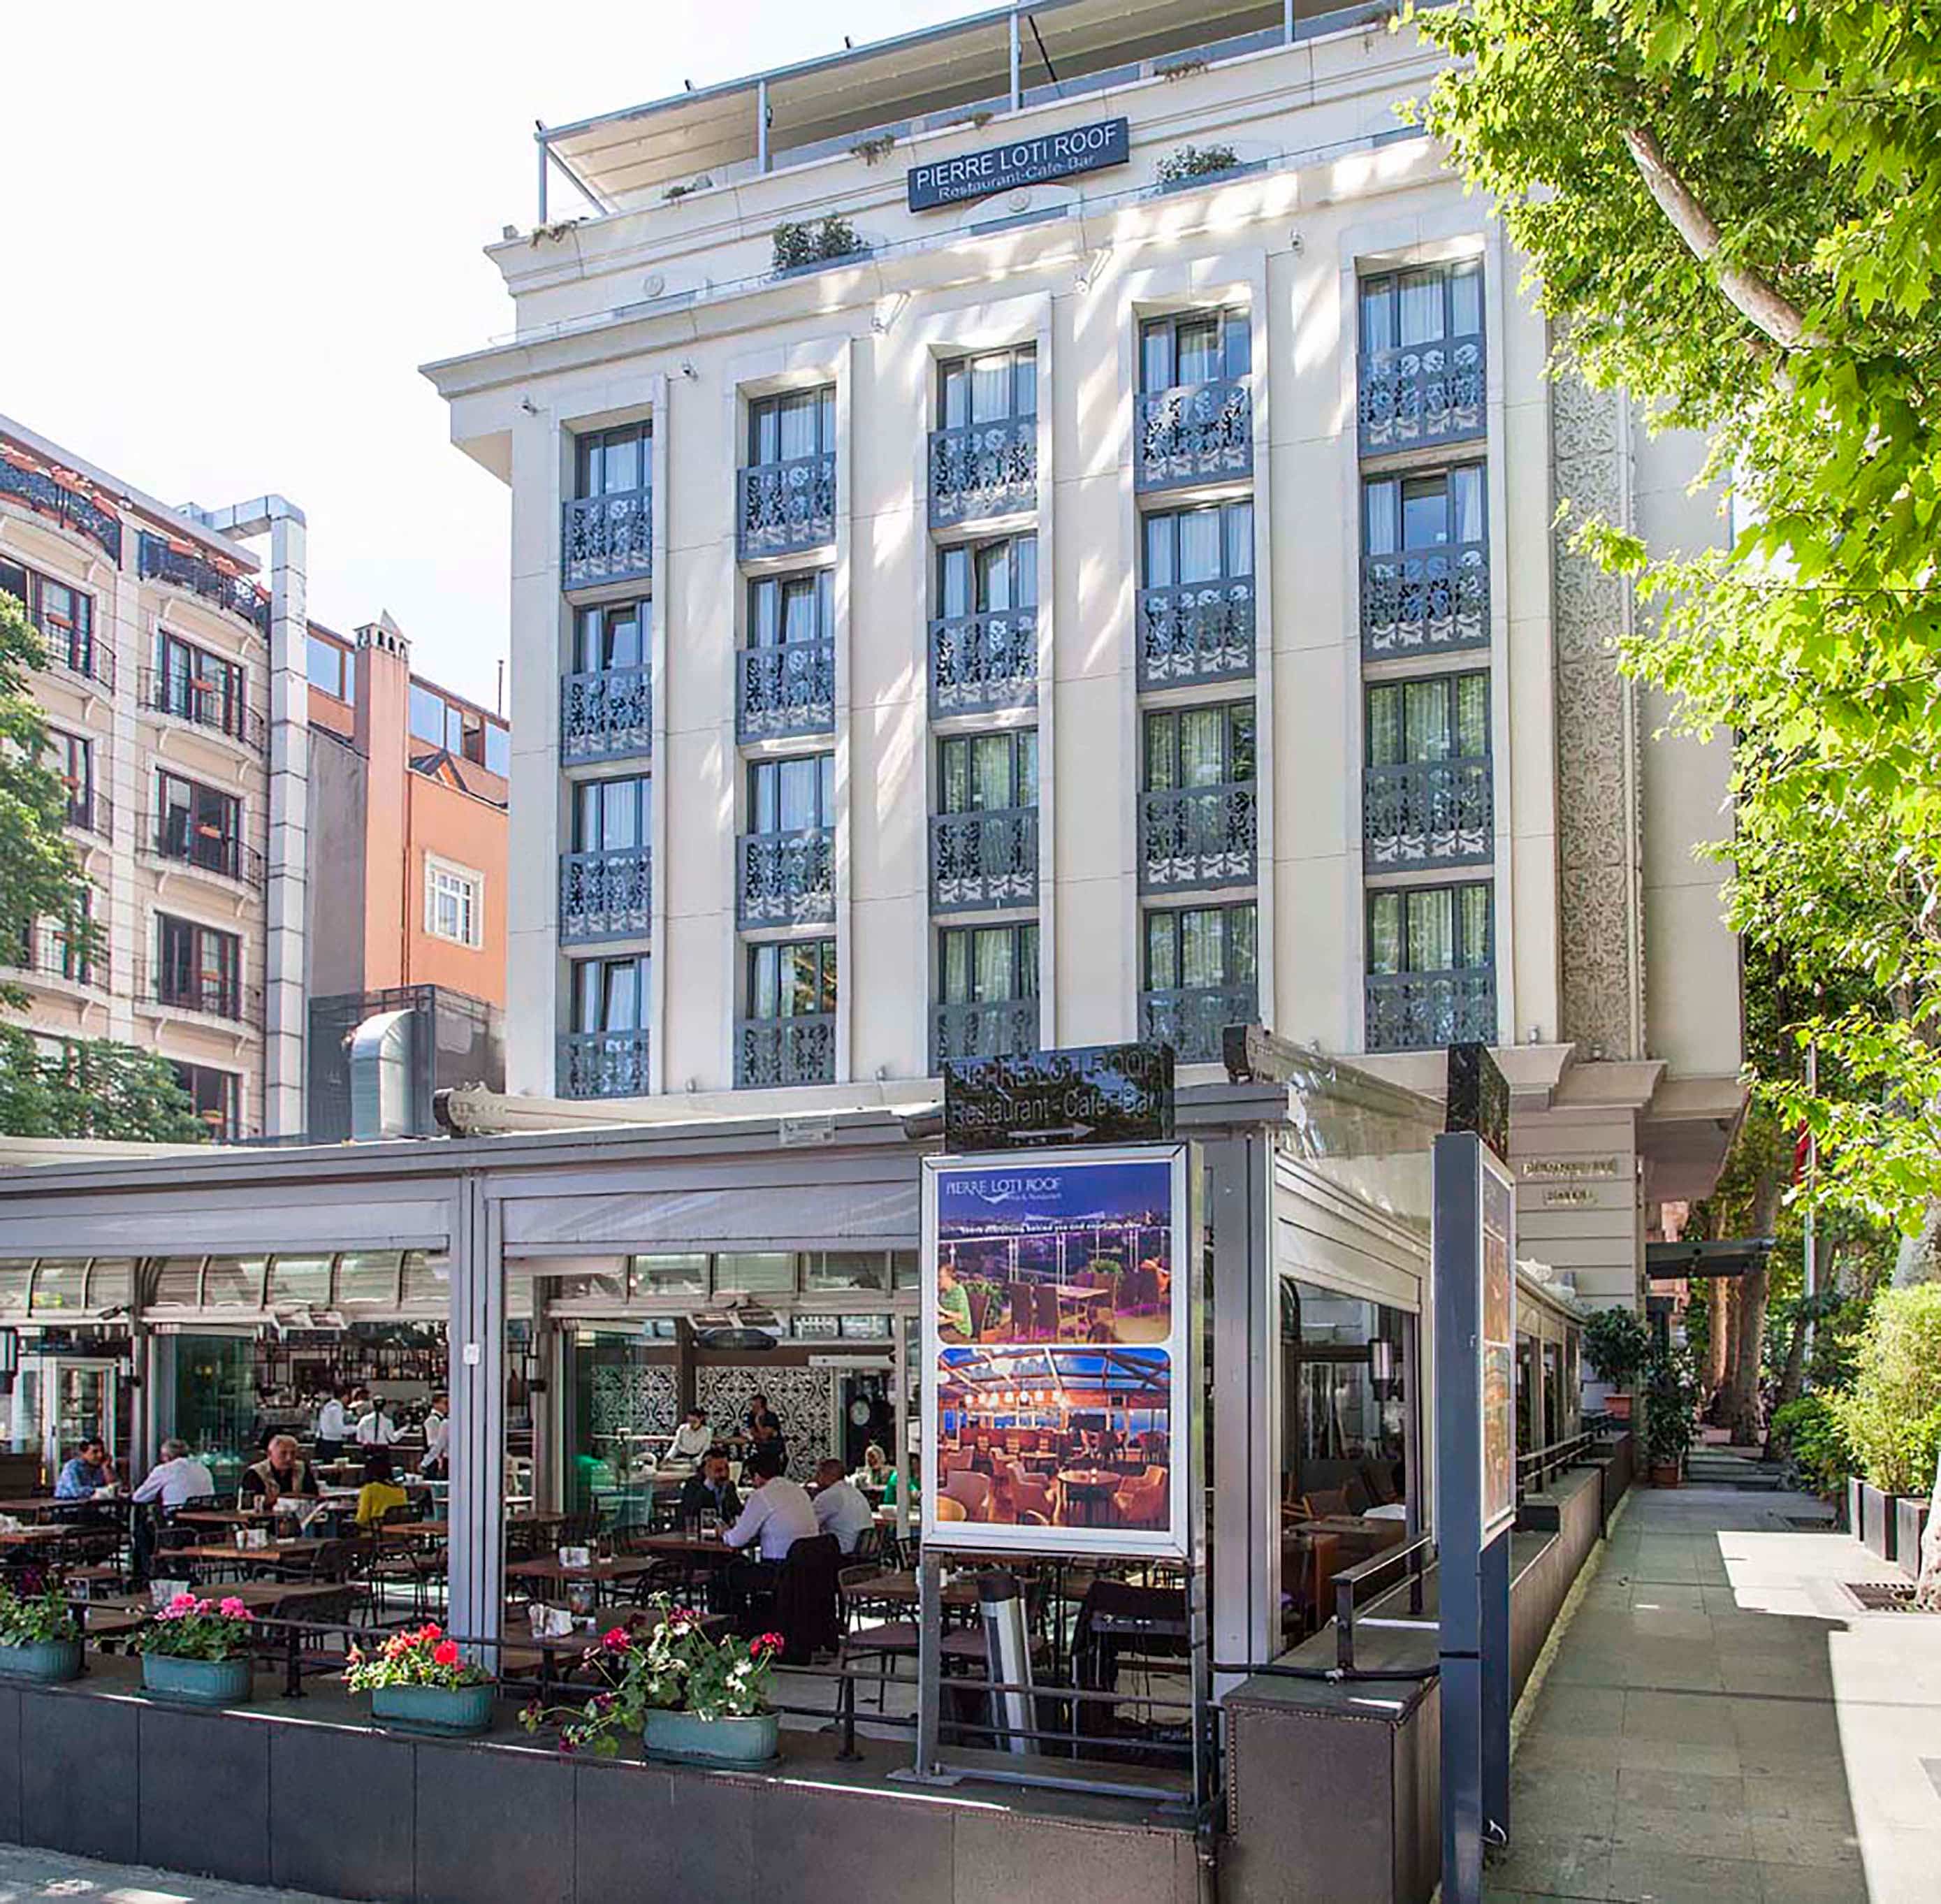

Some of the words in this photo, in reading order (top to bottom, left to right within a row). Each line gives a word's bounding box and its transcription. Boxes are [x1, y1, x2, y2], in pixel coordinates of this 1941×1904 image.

[917, 154, 994, 190] PIERRE
[1001, 142, 1047, 170] LOTI
[1054, 123, 1118, 157] ROOF
[951, 1096, 1049, 1125] Restaurant
[946, 1180, 987, 1196] PIERRE
[991, 1179, 1022, 1193] LOTI
[1026, 1177, 1062, 1191] ROOF
